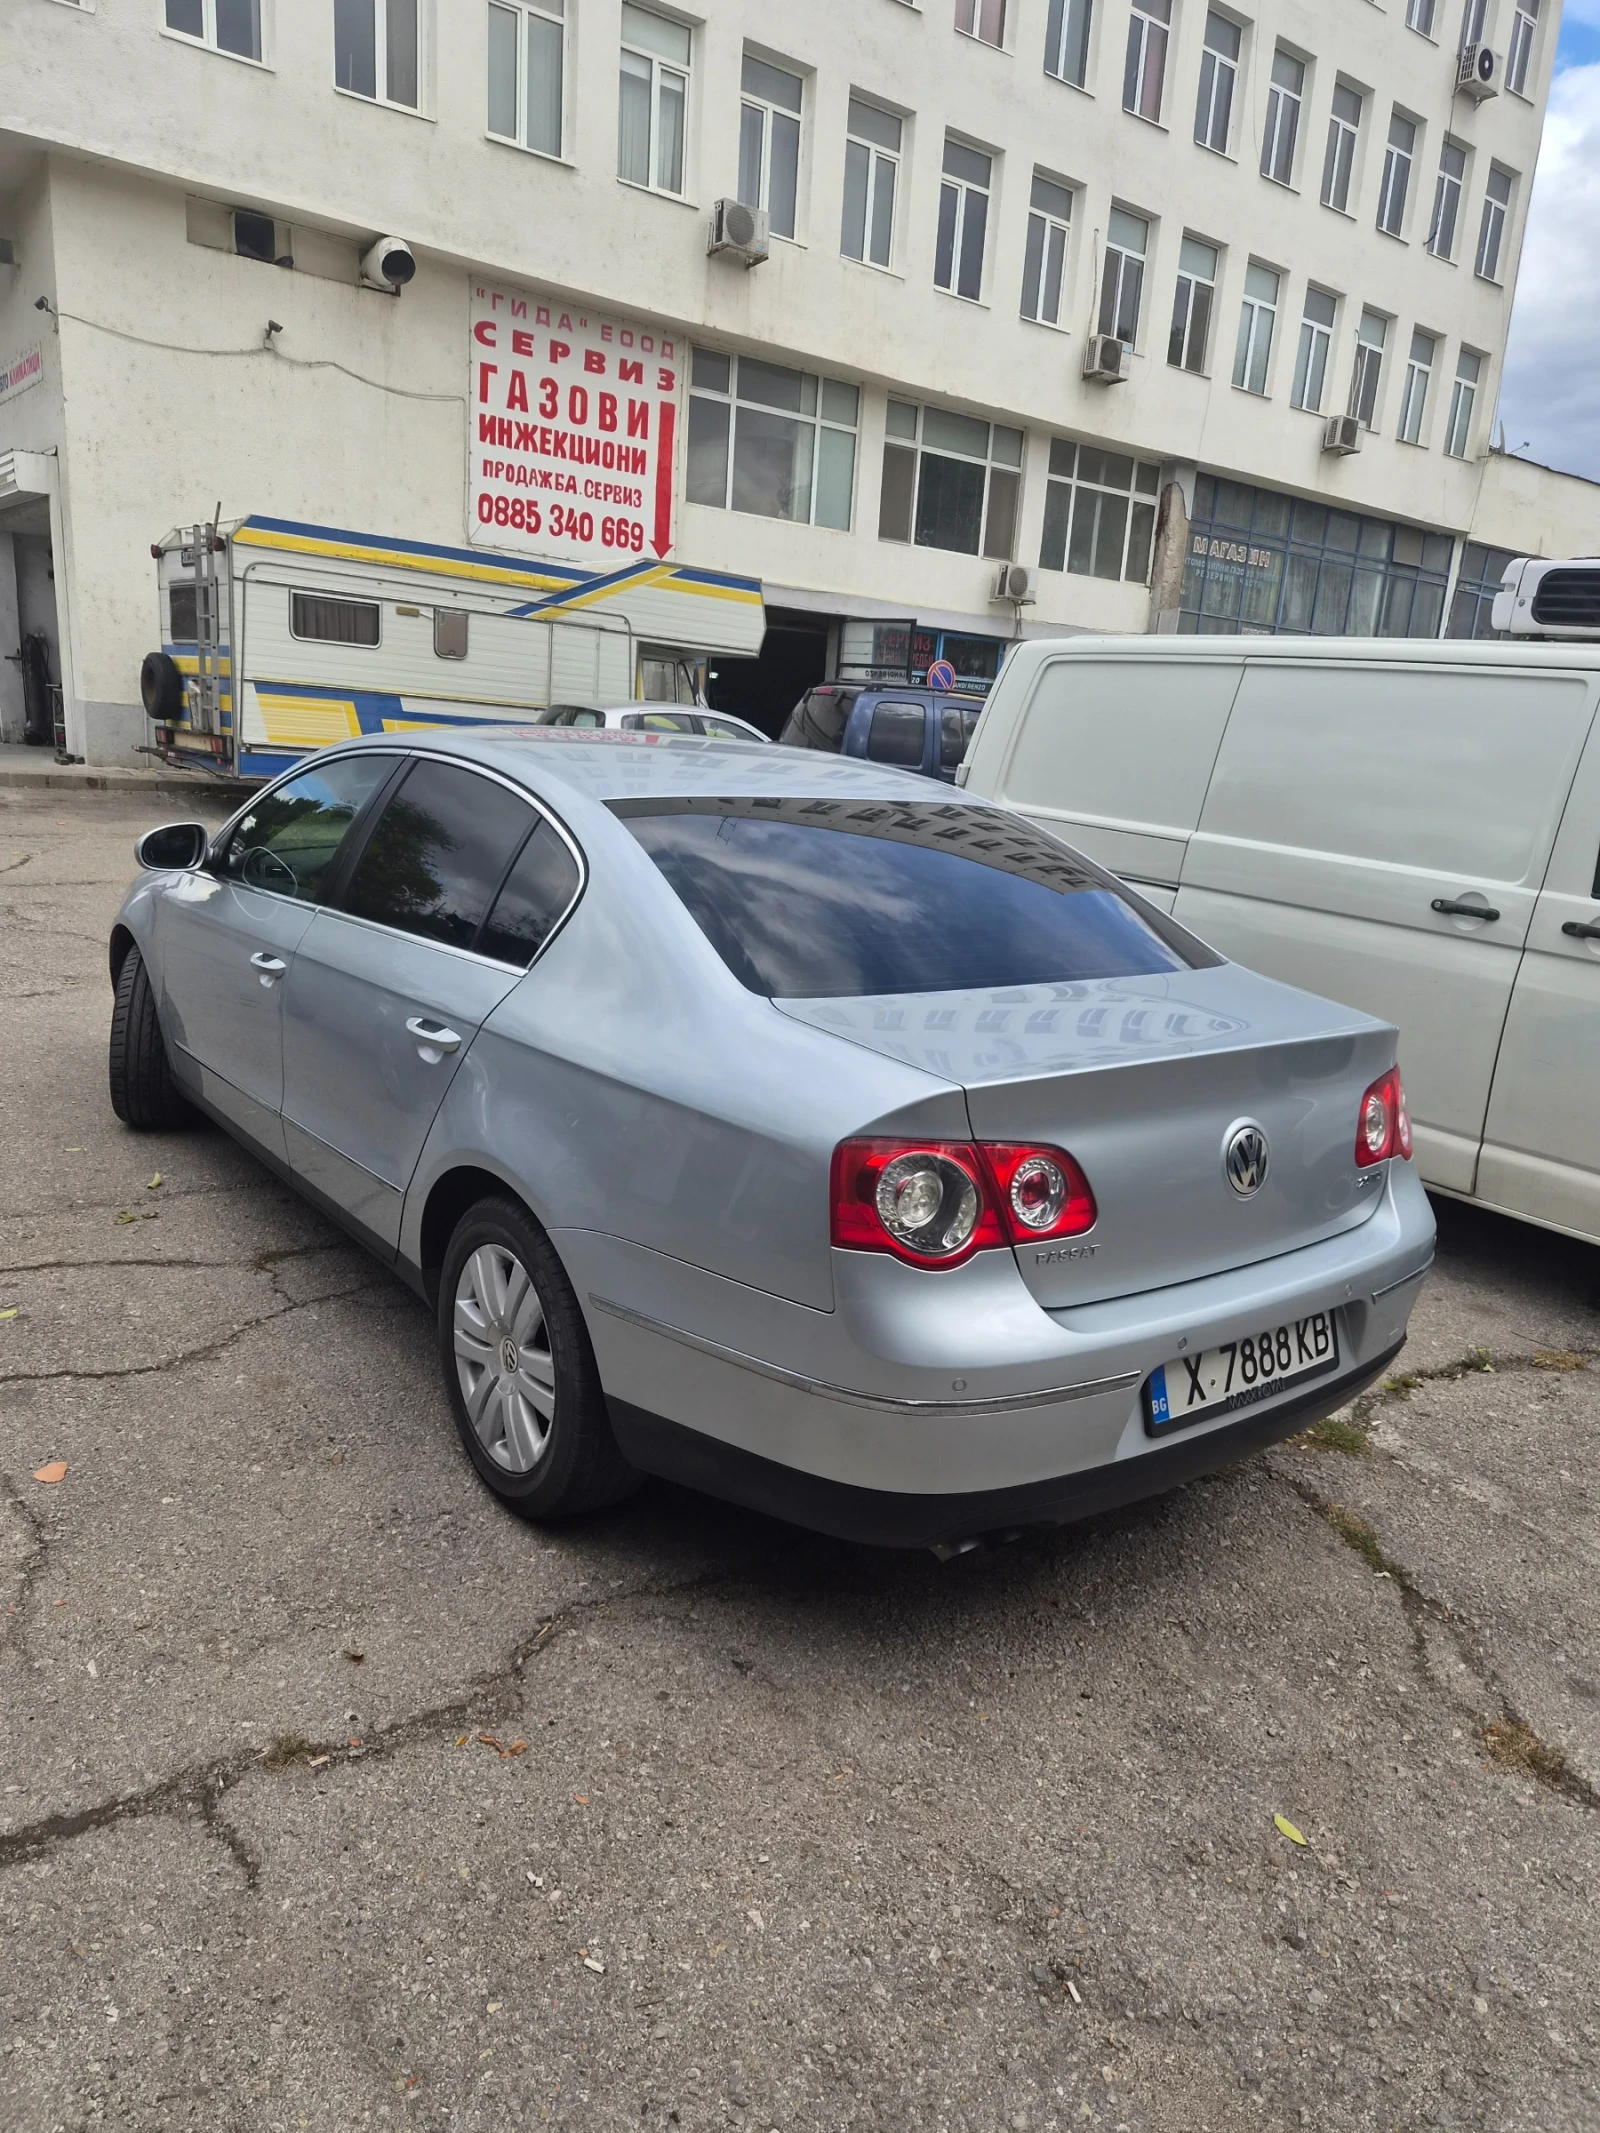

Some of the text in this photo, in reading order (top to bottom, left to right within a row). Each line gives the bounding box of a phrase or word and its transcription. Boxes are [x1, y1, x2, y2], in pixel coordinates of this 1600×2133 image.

[473, 320, 676, 392] СЕРВИЗ
[601, 323, 675, 361] ЕООД
[478, 361, 650, 441] ГАЗОВИ
[478, 412, 648, 476] ИНЖЕКЦИОНИ
[584, 478, 643, 508] СЕРВИЗ
[477, 492, 644, 553] 0885 340 669
[1193, 536, 1271, 568] МАГАЗИН
[1195, 568, 1235, 584] РЕЗЕРВНИ
[967, 682, 986, 692] RENZO
[1036, 1243, 1101, 1265] PASSAT
[1219, 1326, 1292, 1394] 7888
[1151, 1396, 1168, 1415] BG
